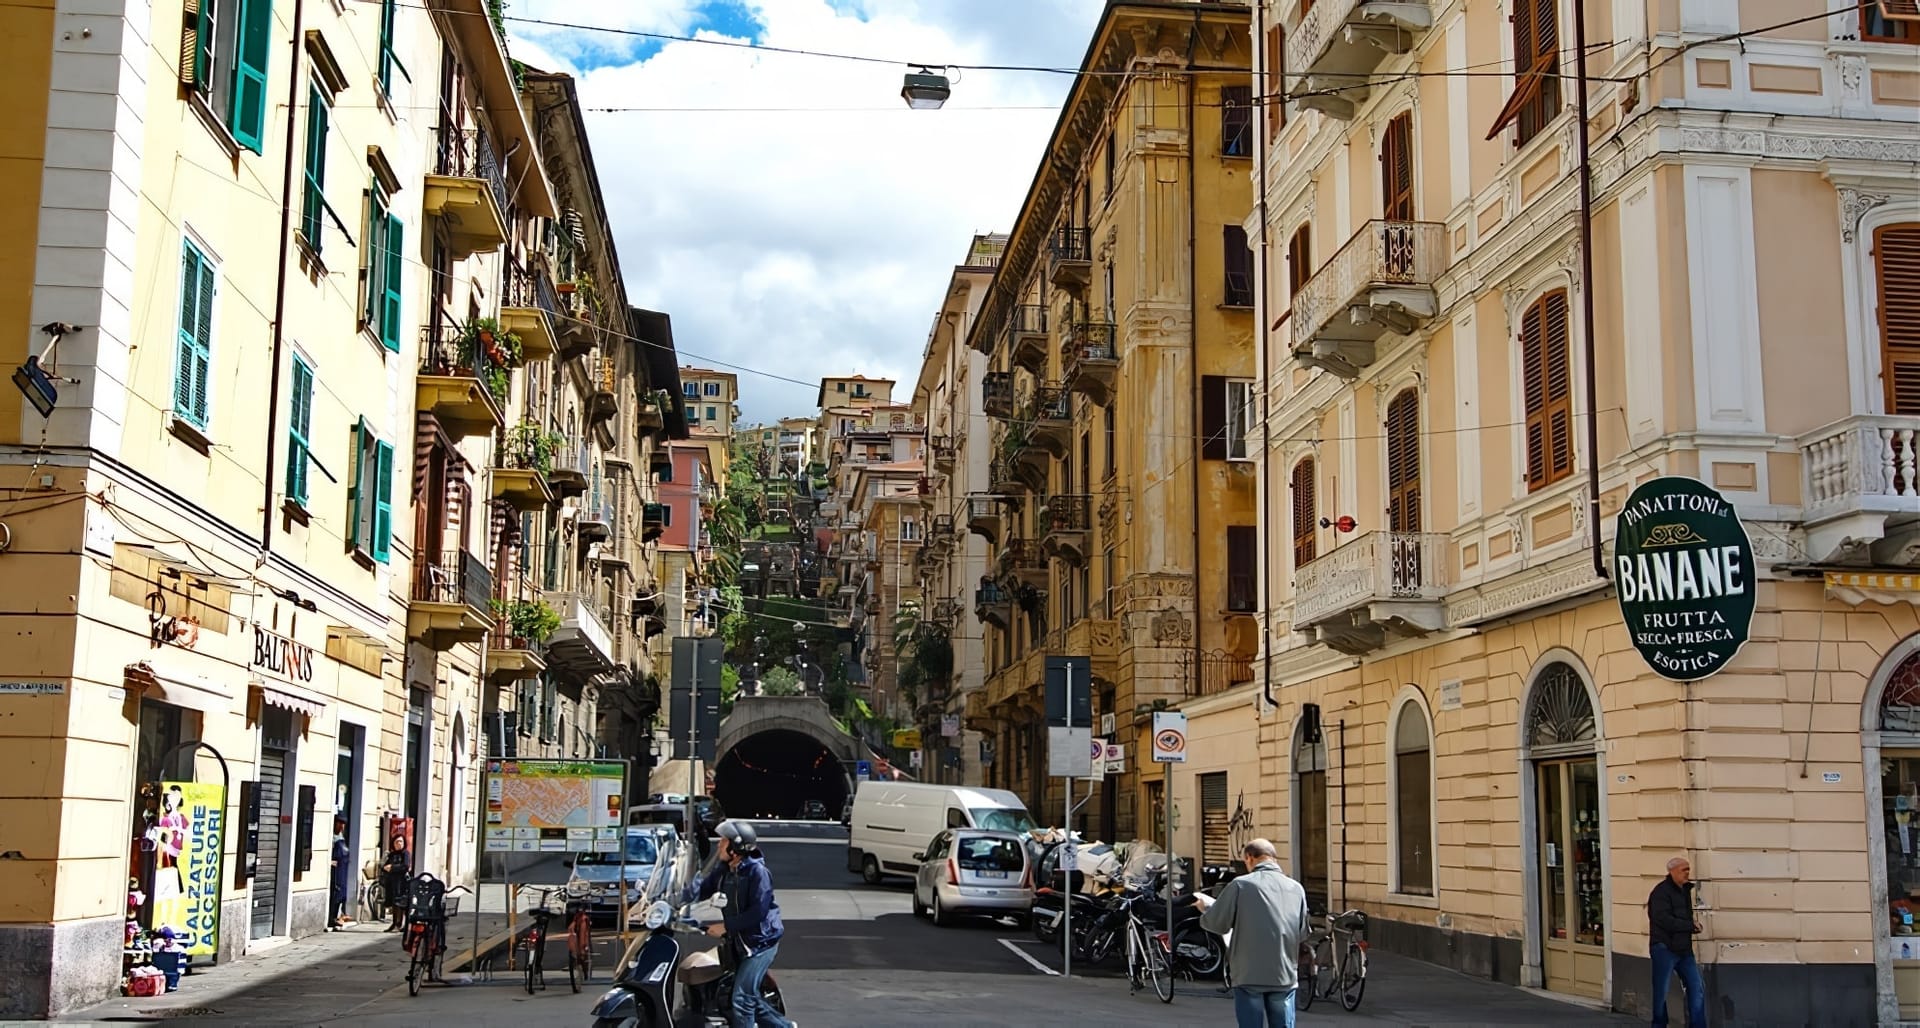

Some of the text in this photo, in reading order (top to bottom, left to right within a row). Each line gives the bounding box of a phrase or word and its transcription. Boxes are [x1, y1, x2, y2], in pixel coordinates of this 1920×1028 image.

[1624, 494, 1719, 526] PANATTONI
[1618, 545, 1744, 603] BANANE
[1643, 610, 1725, 628] FRUTTA
[1653, 650, 1720, 672] ESOTICA
[185, 805, 207, 948] CALZATURE
[200, 809, 223, 947] ACCESSORI
